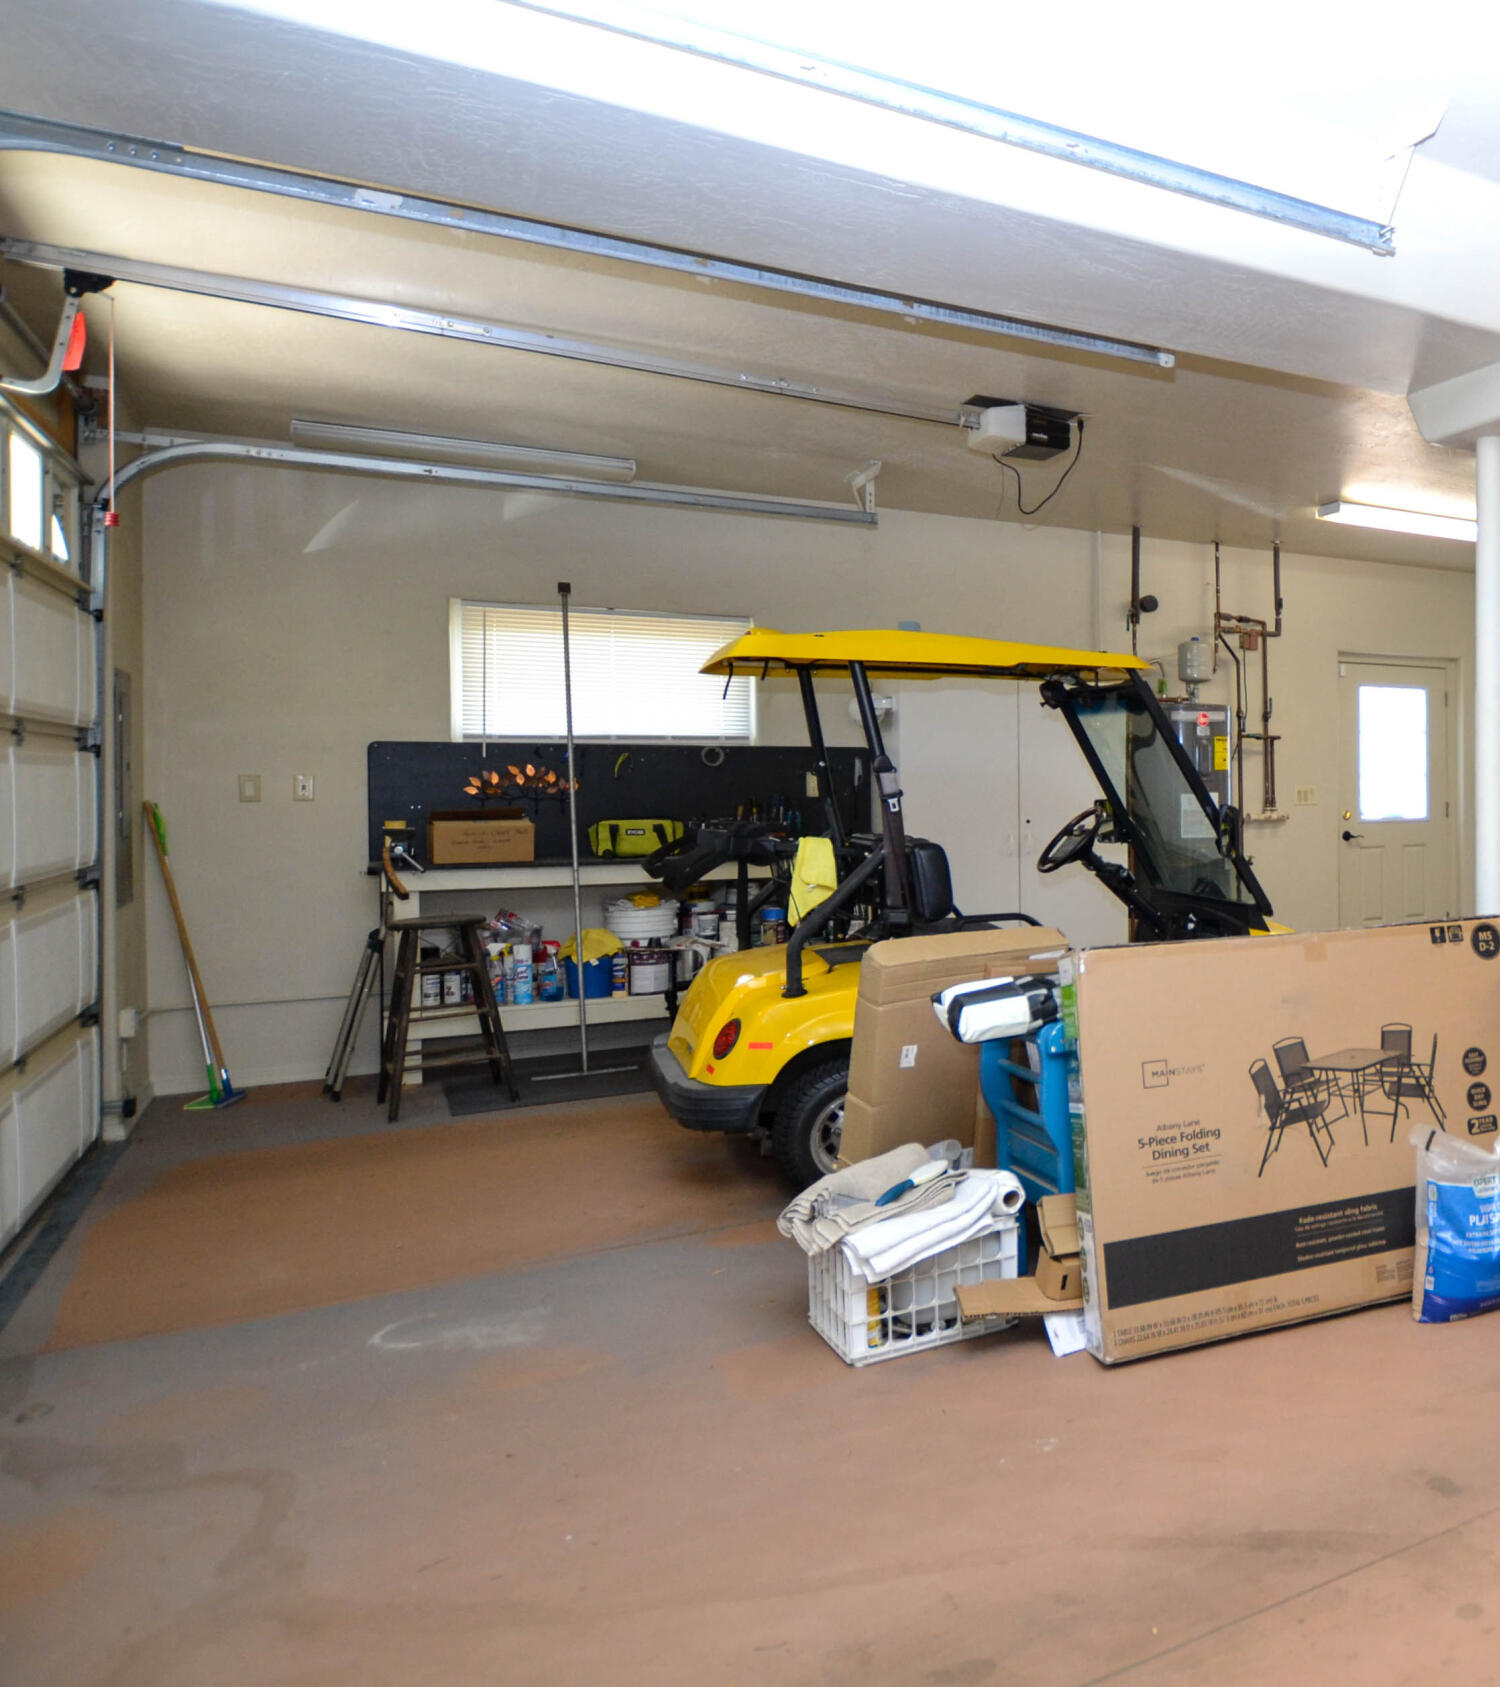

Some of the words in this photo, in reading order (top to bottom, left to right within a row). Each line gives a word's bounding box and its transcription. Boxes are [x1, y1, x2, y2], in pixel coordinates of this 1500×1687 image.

[1479, 930, 1493, 940] MS
[1479, 940, 1496, 952] D-2
[1470, 1119, 1481, 1135] 2
[1137, 1135, 1177, 1150] 5-Piece
[1180, 1128, 1221, 1142] Folding
[1152, 1146, 1190, 1161] Dining
[1192, 1142, 1210, 1154] Set
